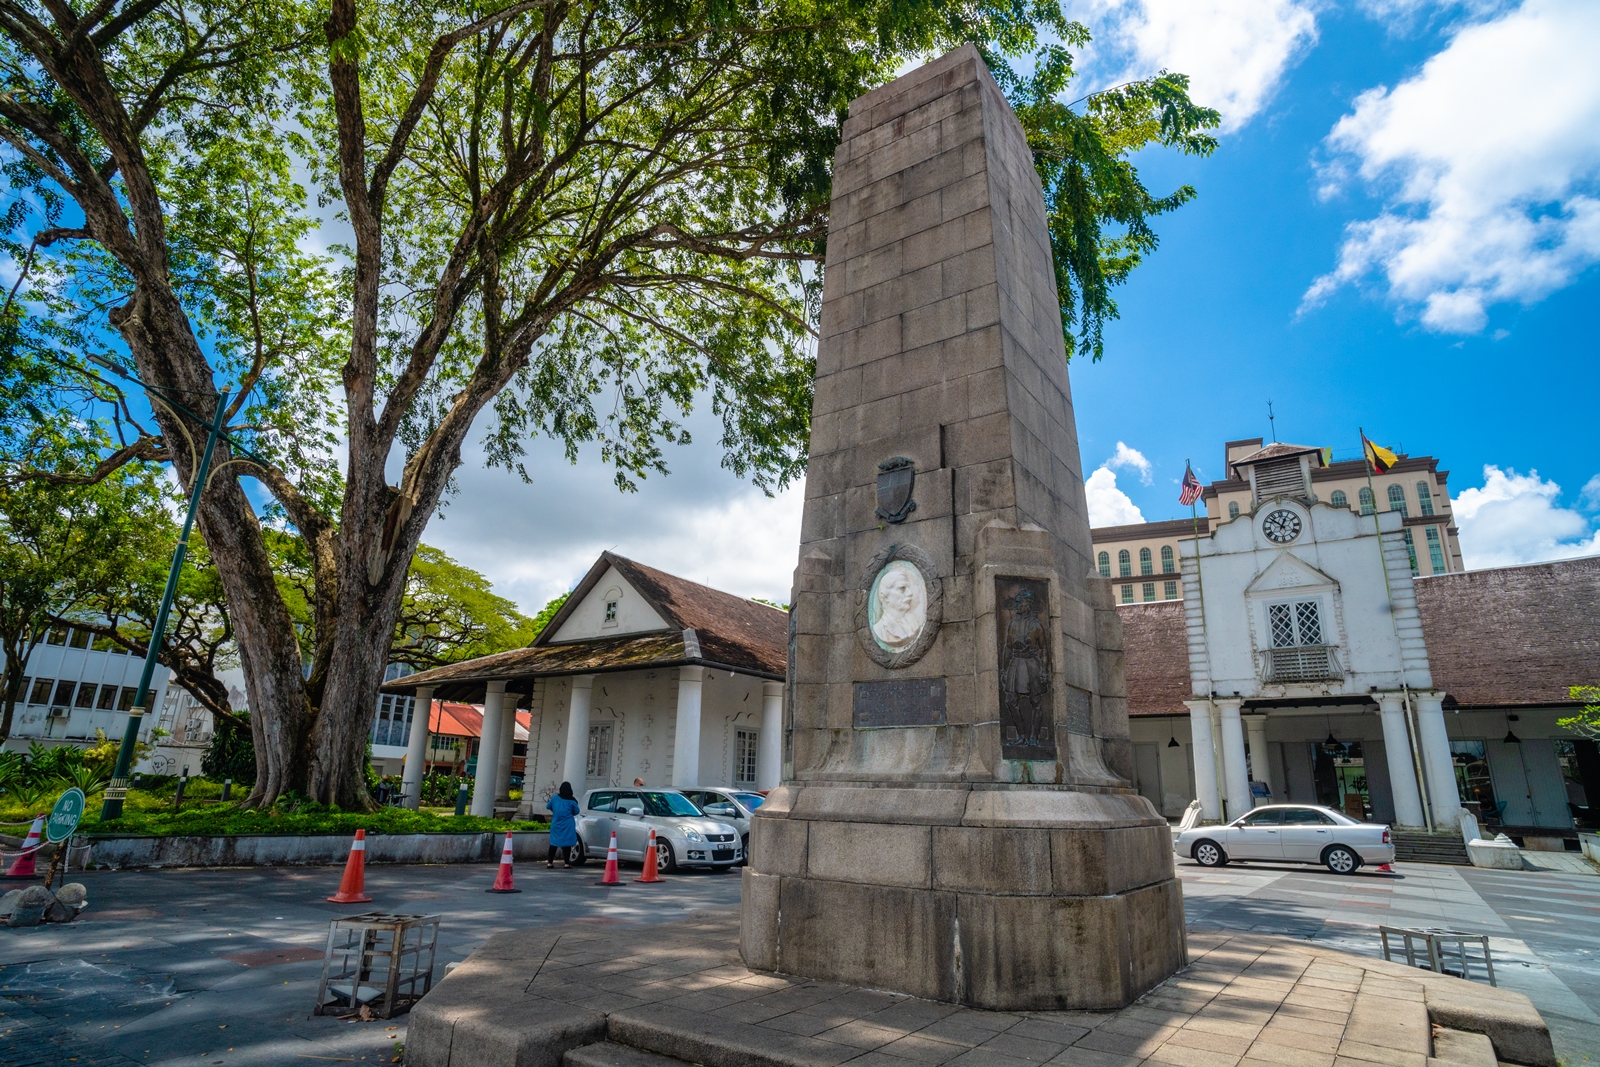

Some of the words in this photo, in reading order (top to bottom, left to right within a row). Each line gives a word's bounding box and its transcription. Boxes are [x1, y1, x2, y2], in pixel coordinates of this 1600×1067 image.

[1277, 575, 1301, 587] 1883
[62, 799, 73, 812] NO
[53, 813, 77, 826] PARKING
